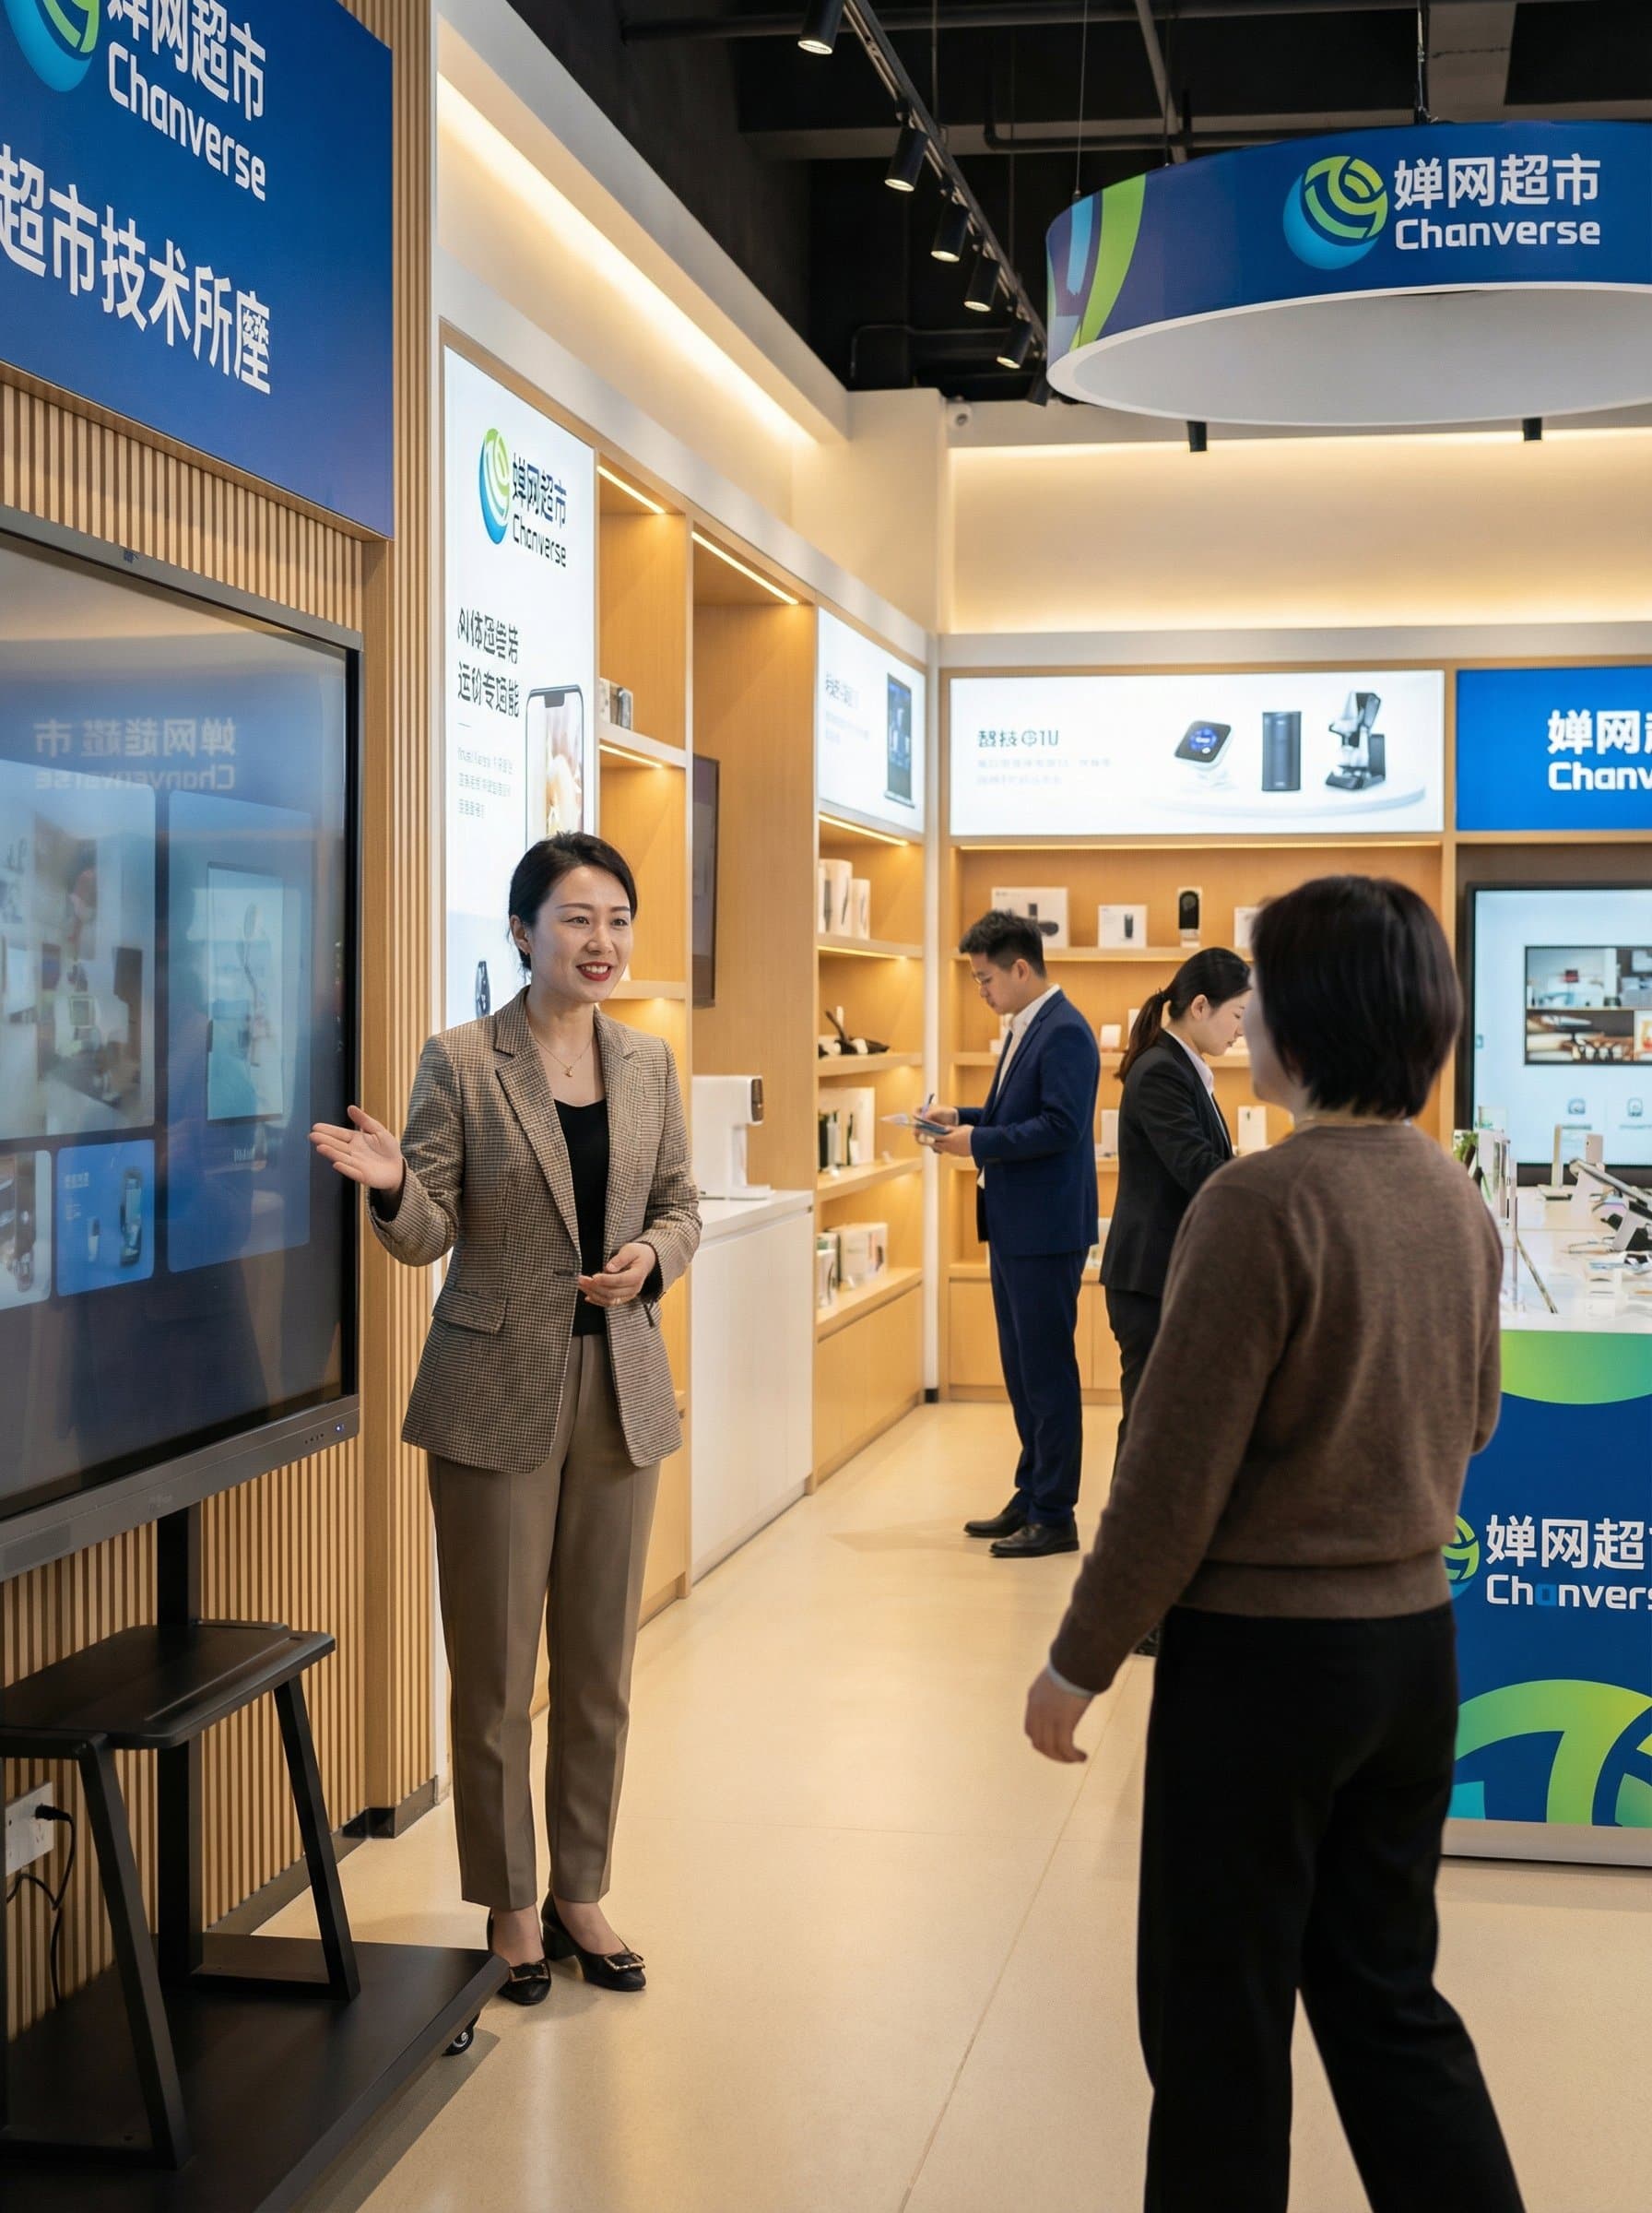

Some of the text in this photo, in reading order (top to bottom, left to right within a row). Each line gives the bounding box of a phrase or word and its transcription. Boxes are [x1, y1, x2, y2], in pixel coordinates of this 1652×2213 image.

[109, 41, 266, 201] Chanverse
[1394, 153, 1600, 210] 婵网超市
[1395, 219, 1600, 250] Chanverse
[1548, 709, 1652, 754] 婵网
[1486, 1514, 1652, 1570] 婵网超
[1487, 1574, 1652, 1611] Chanver
